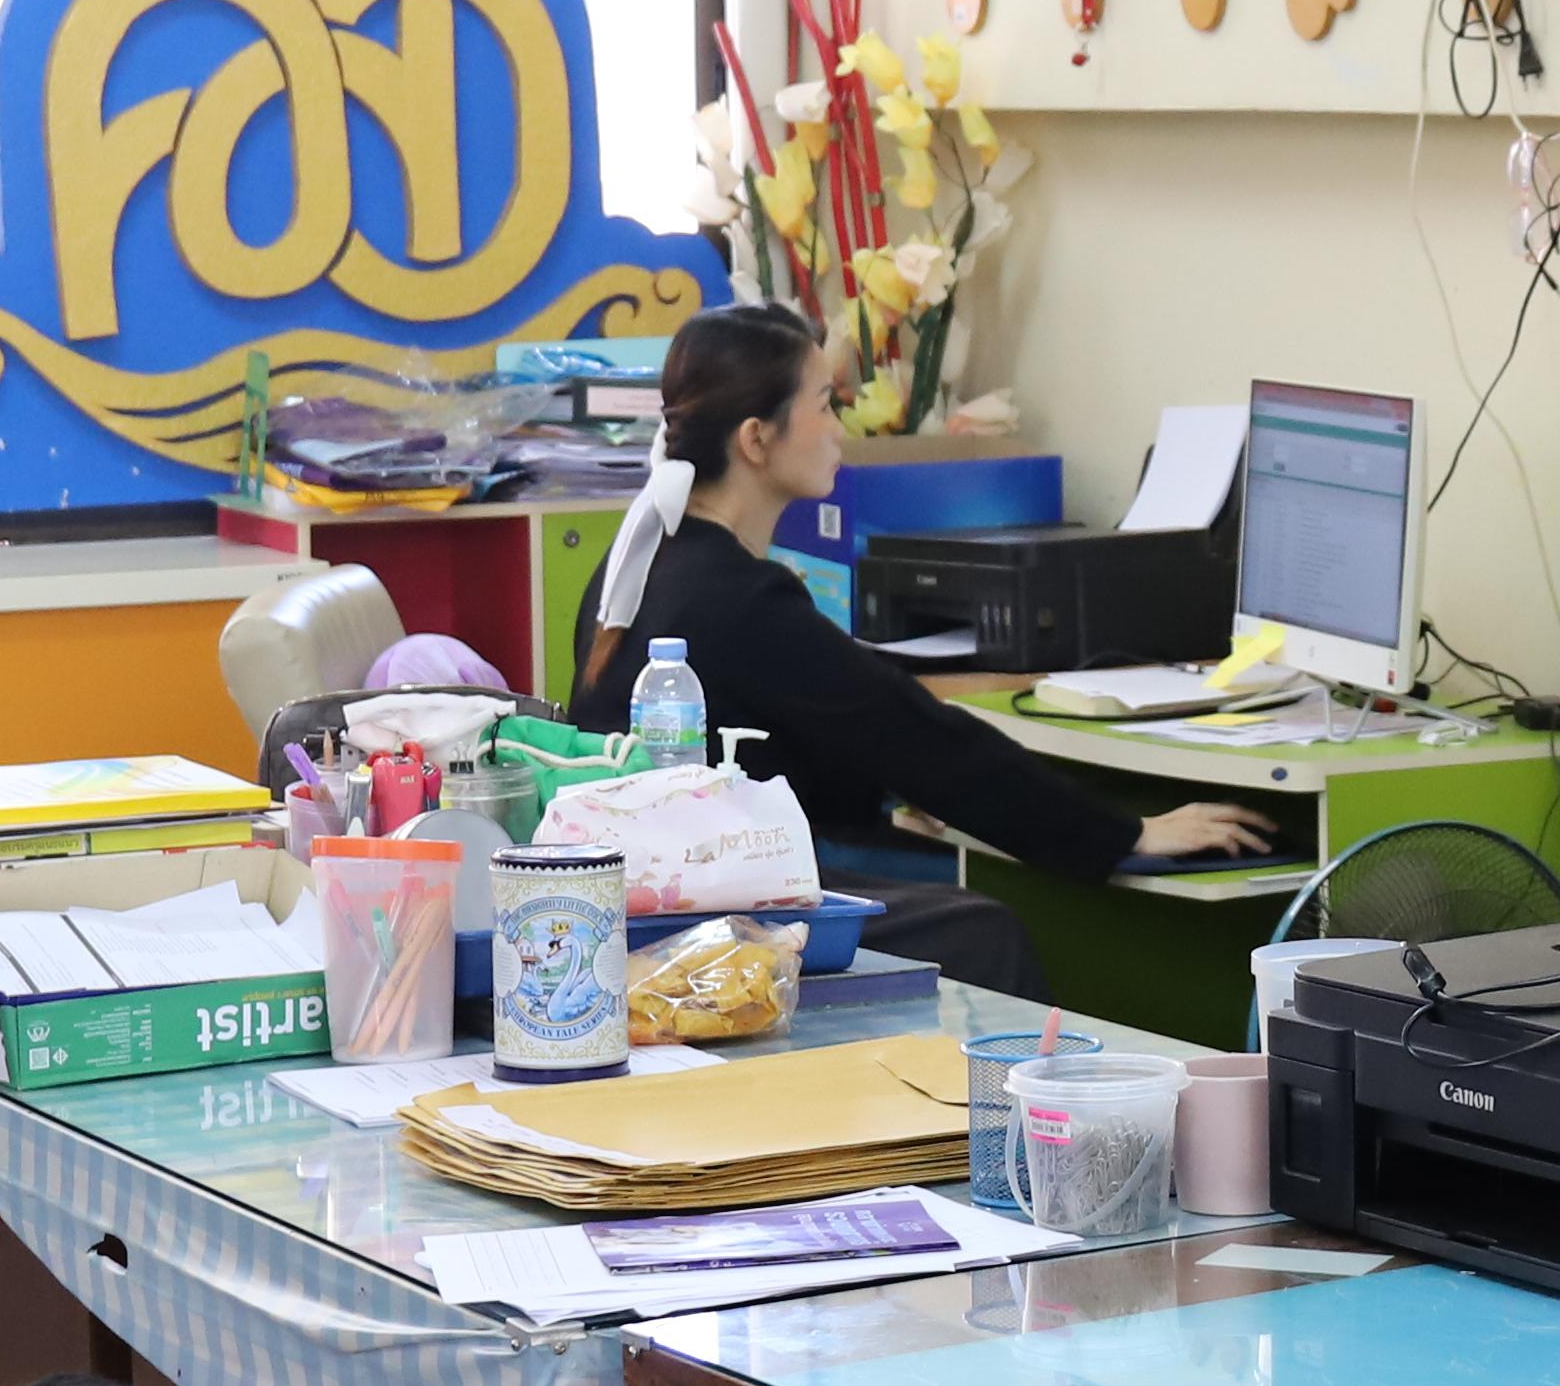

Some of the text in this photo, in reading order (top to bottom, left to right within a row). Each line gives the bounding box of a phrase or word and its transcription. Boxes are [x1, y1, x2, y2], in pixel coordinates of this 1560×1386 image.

[197, 996, 324, 1052] artist
[511, 1007, 553, 1037] EUROPEAN
[555, 1023, 580, 1038] TALE
[1438, 1079, 1496, 1113] Canon
